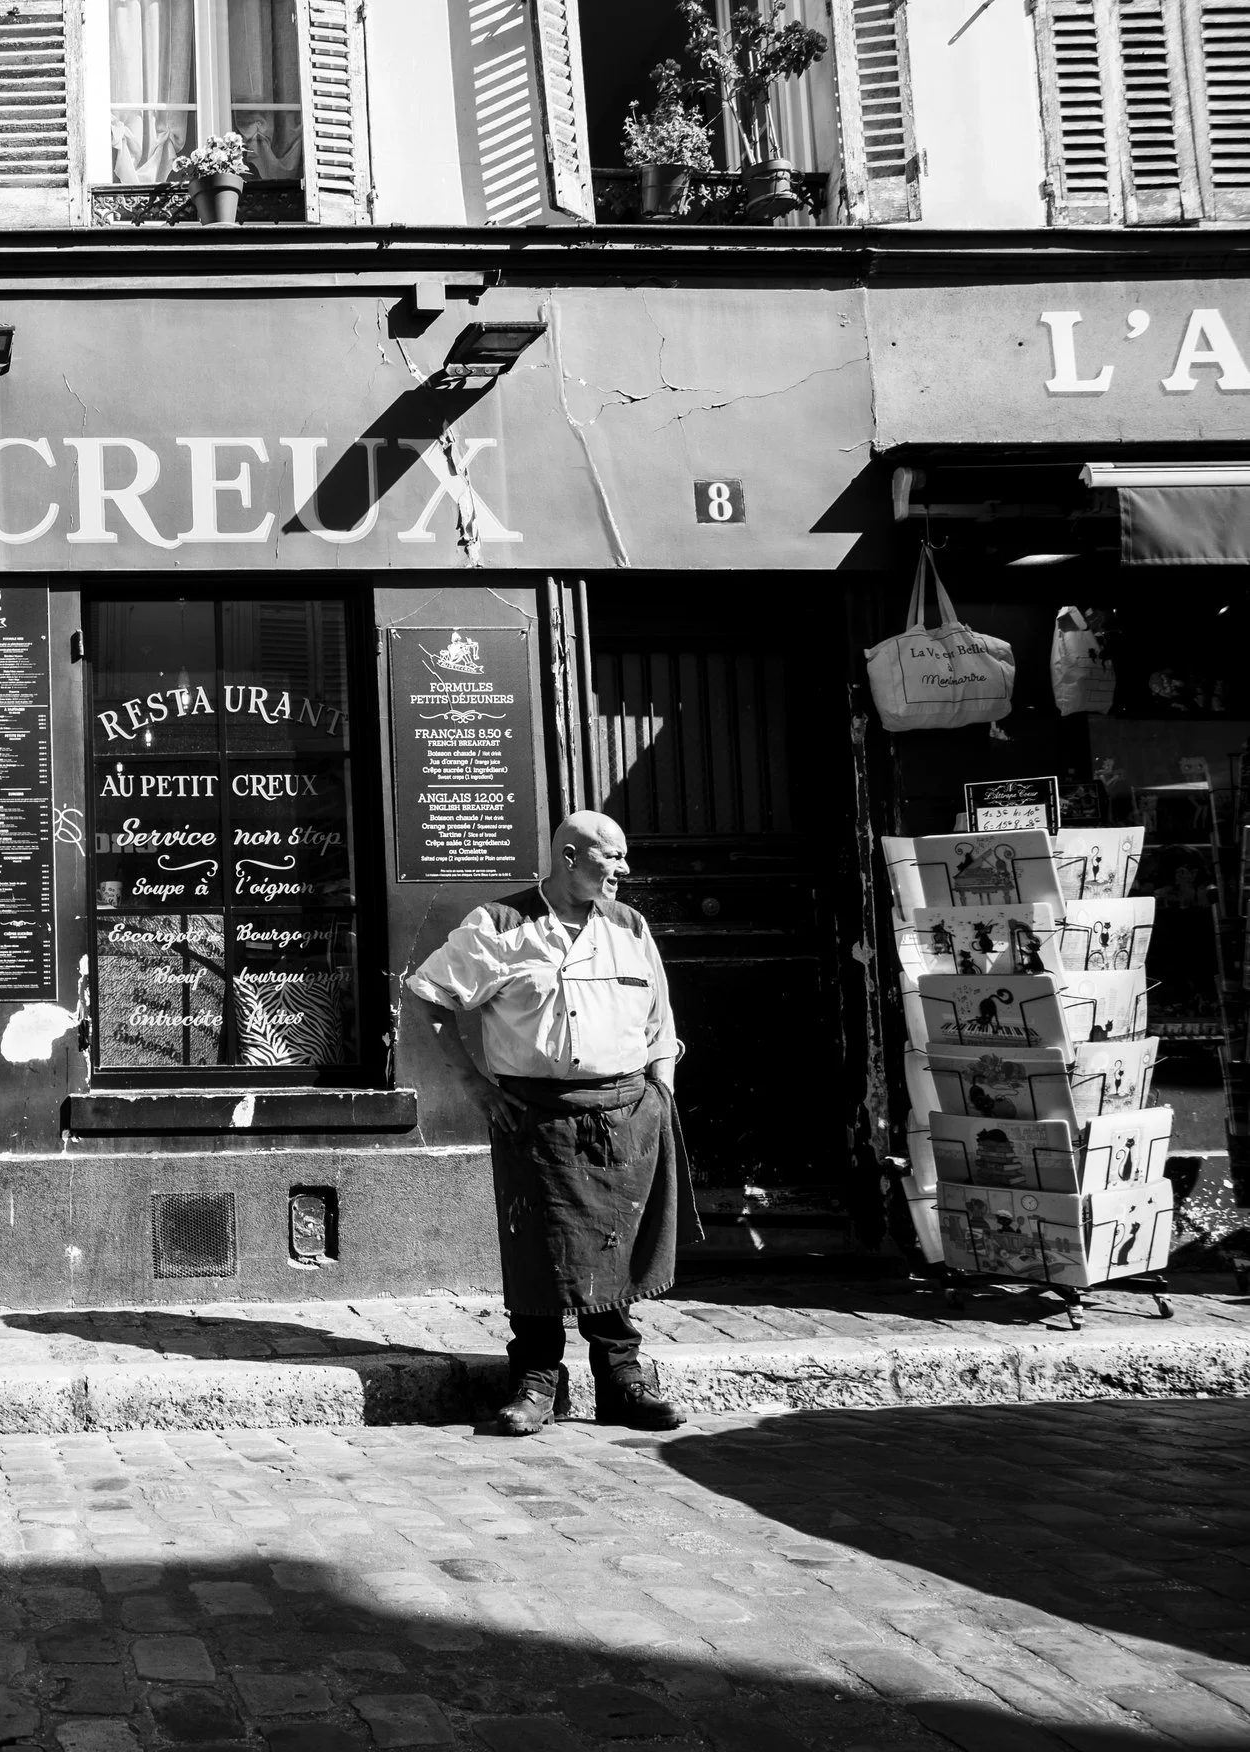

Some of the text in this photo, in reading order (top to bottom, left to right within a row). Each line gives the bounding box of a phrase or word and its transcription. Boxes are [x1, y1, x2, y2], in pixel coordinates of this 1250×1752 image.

[708, 482, 732, 522] 8
[910, 648, 925, 658] La
[410, 692, 514, 704] PETITS DÉJEUNERS
[430, 683, 493, 692] FORMULES
[414, 729, 513, 740] FRANÇAIS 8,50 €
[442, 758, 468, 766] d'orange
[100, 774, 318, 801] AU PETIT CREUX
[417, 793, 515, 804] ANGLAIS 12,00 €
[116, 818, 217, 847] Service
[233, 829, 282, 846] non
[288, 825, 343, 856] stop
[132, 878, 185, 902] Soupe
[194, 878, 209, 896] à
[108, 923, 205, 950] Escargots
[153, 965, 207, 991] Boeuf
[129, 1005, 224, 1026] Entrecôte
